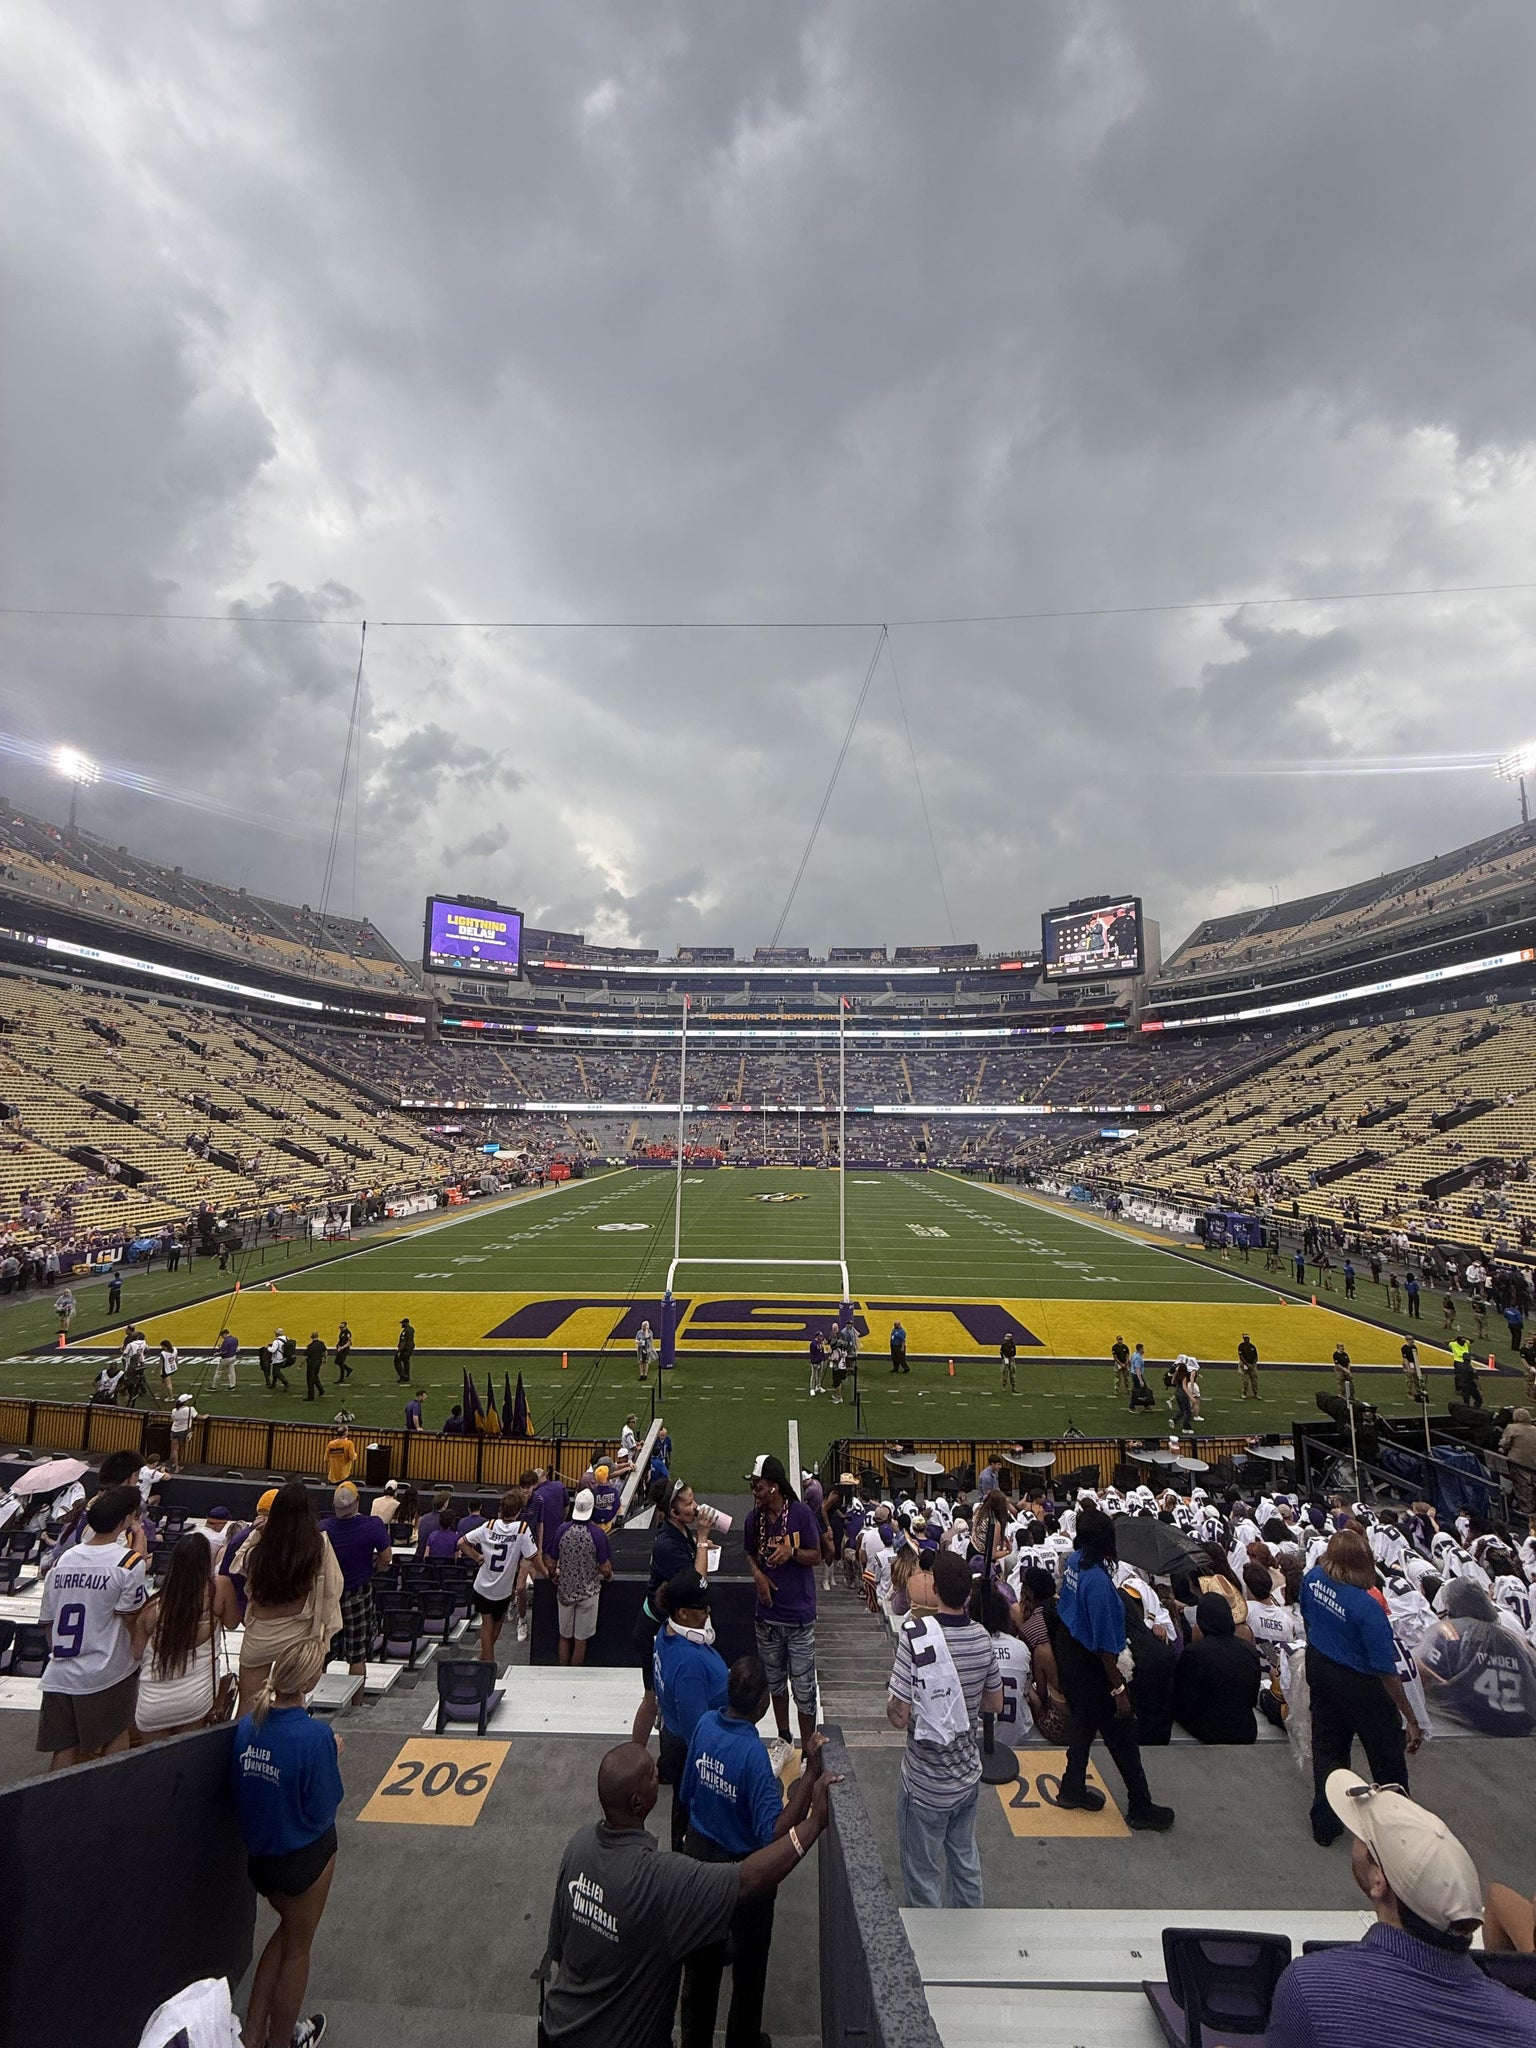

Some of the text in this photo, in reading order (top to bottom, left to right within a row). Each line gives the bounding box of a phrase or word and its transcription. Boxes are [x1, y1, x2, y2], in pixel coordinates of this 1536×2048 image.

[447, 914, 507, 933] LIGHTNING
[458, 925, 496, 939] DELAY
[70, 983, 84, 992] 304
[1485, 994, 1498, 1003] 102
[482, 1298, 1046, 1346] LSU
[490, 1544, 508, 1572] 2
[54, 1573, 111, 1591] BURREAUX
[1313, 1579, 1337, 1599] ALLIED
[1313, 1588, 1346, 1617] UNIVERSAL
[53, 1603, 86, 1658] 9
[1259, 1616, 1283, 1632] TIGERS
[993, 1647, 1011, 1660] ERS
[1473, 1668, 1526, 1713] 42
[245, 1745, 271, 1761] ALLIED
[700, 1752, 725, 1775] ALLIED
[244, 1758, 280, 1780] UNIVERSAL
[380, 1760, 493, 1798] 206
[700, 1765, 738, 1798] UNIVERSAL
[1009, 1773, 1107, 1810] 20
[575, 1872, 604, 1904] ALLIED
[573, 1890, 618, 1933] UNIVERSAL
[572, 1911, 620, 1943] EVENT SERVICES
[1131, 1950, 1142, 1958] 10
